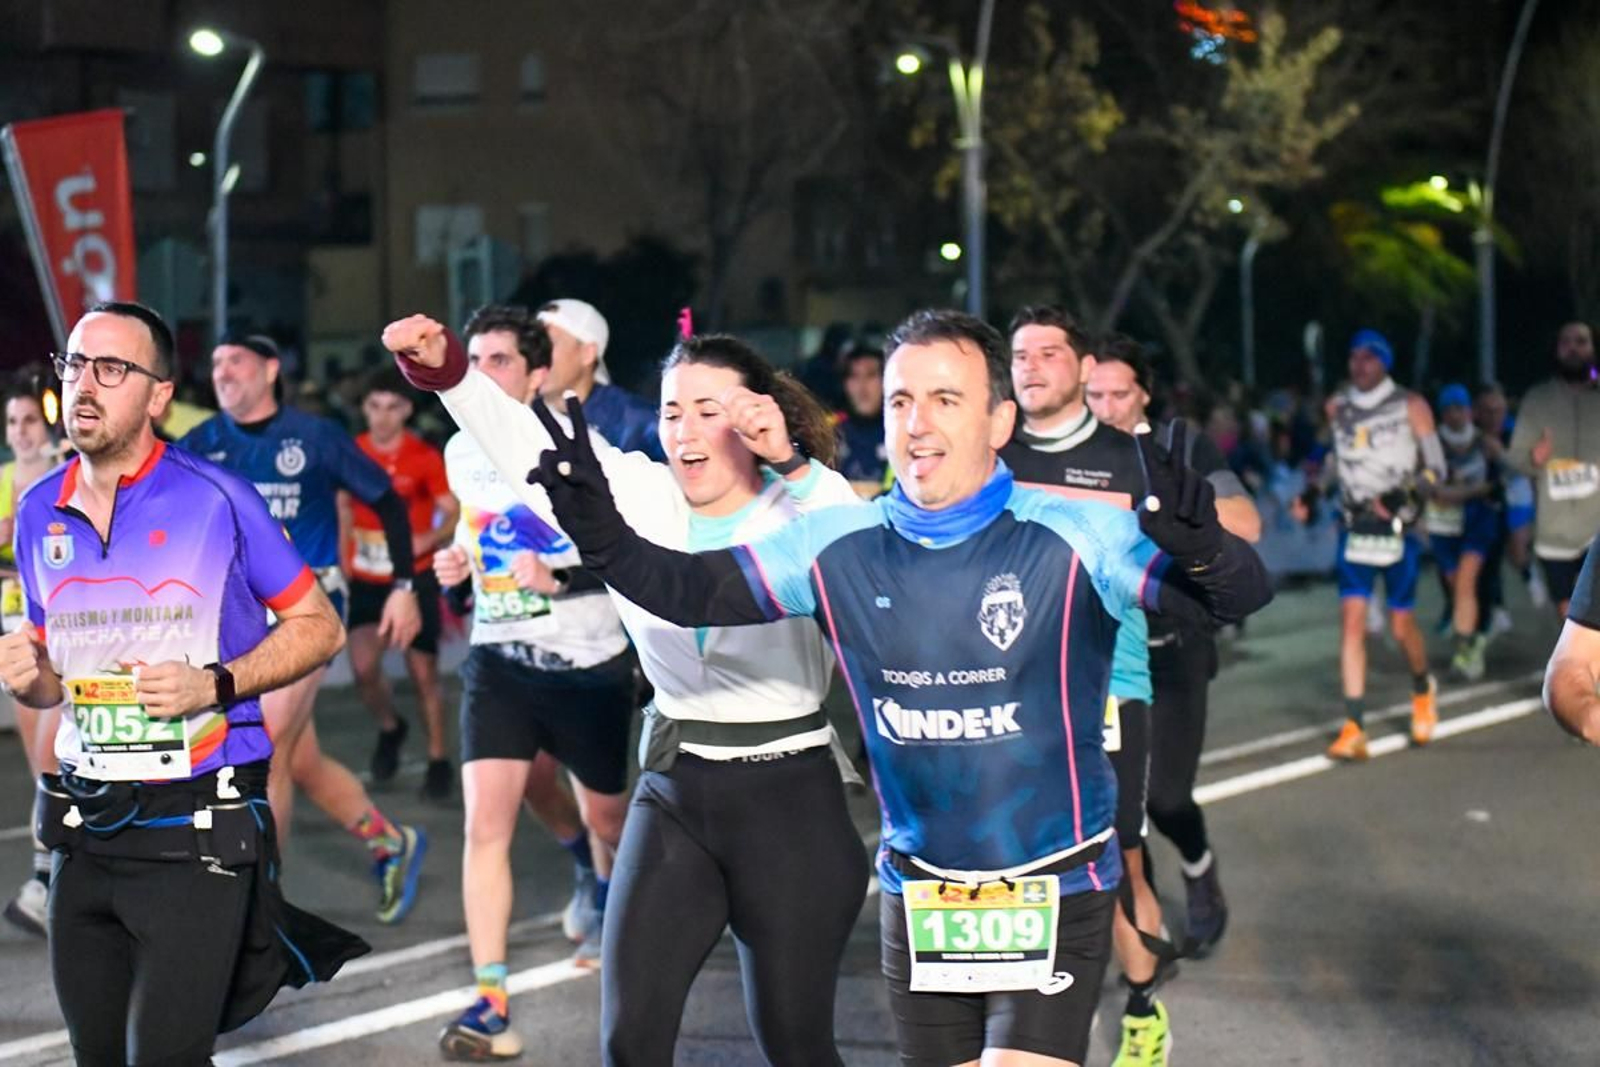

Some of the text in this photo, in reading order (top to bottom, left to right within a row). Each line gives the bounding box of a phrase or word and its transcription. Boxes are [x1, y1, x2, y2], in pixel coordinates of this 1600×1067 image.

[132, 623, 193, 642] REAL
[934, 672, 947, 685] A
[948, 667, 1006, 684] CORRER
[76, 706, 175, 743] 2052
[922, 910, 1045, 950] 1309
